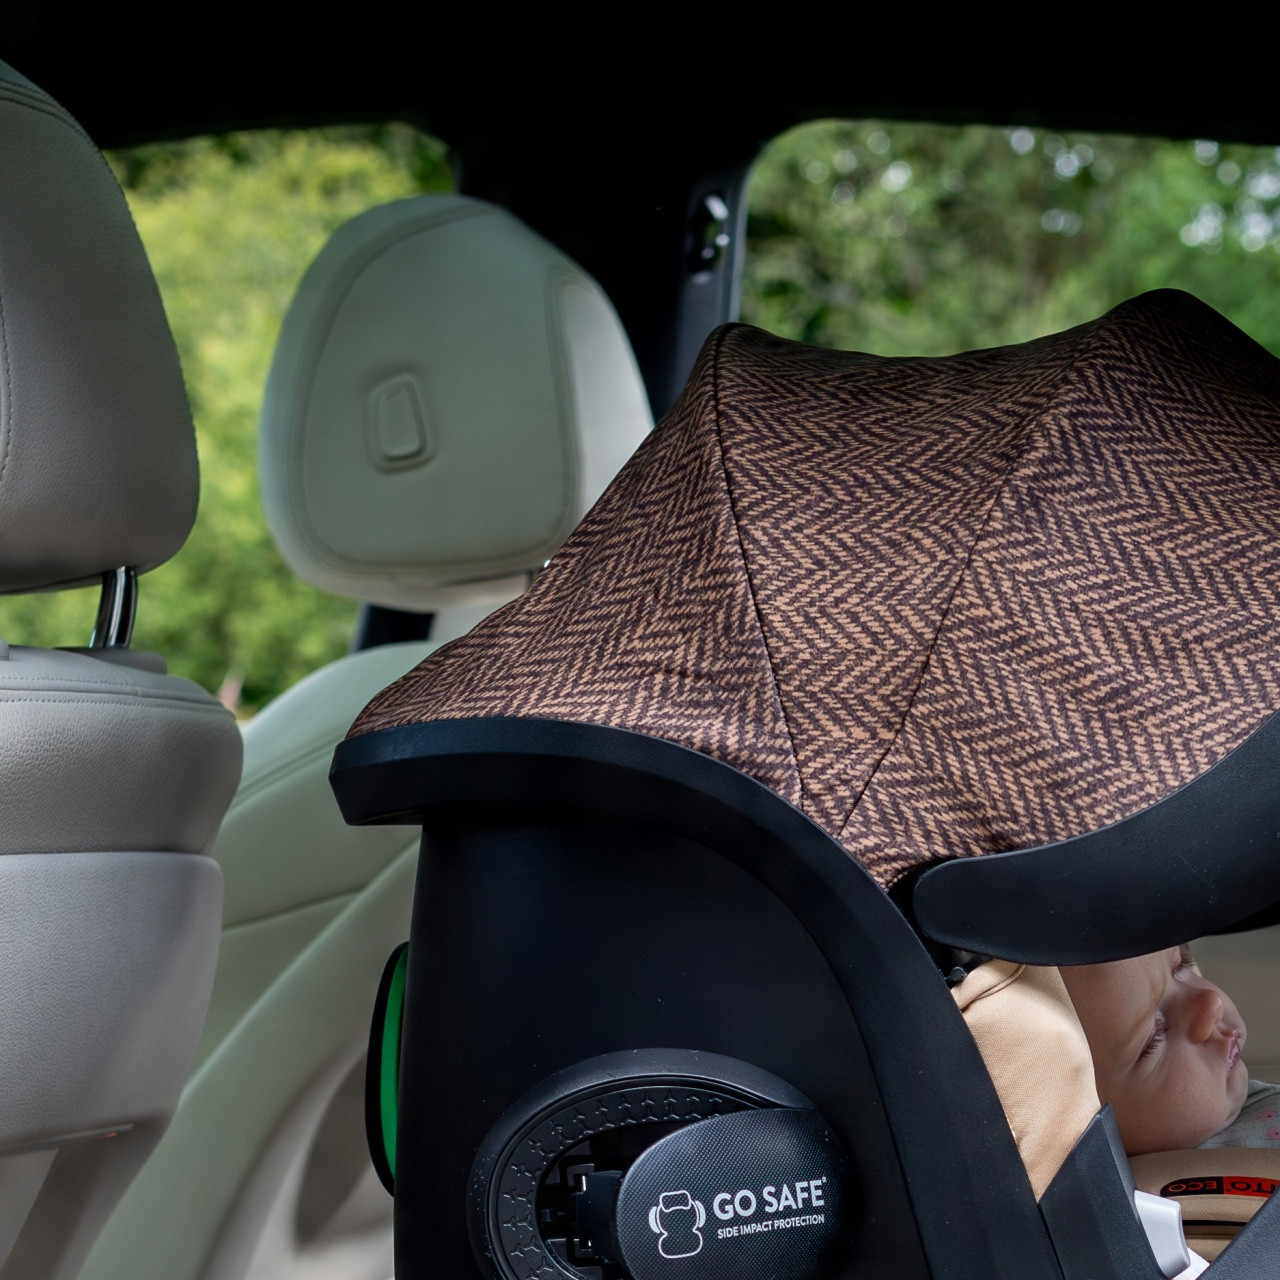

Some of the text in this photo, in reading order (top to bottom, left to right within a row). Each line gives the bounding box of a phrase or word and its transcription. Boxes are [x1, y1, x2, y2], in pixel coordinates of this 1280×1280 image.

[1168, 1181, 1217, 1192] ECO
[713, 1190, 756, 1220] GO
[718, 1214, 825, 1239] SIDE IMPACT PROTECTION
